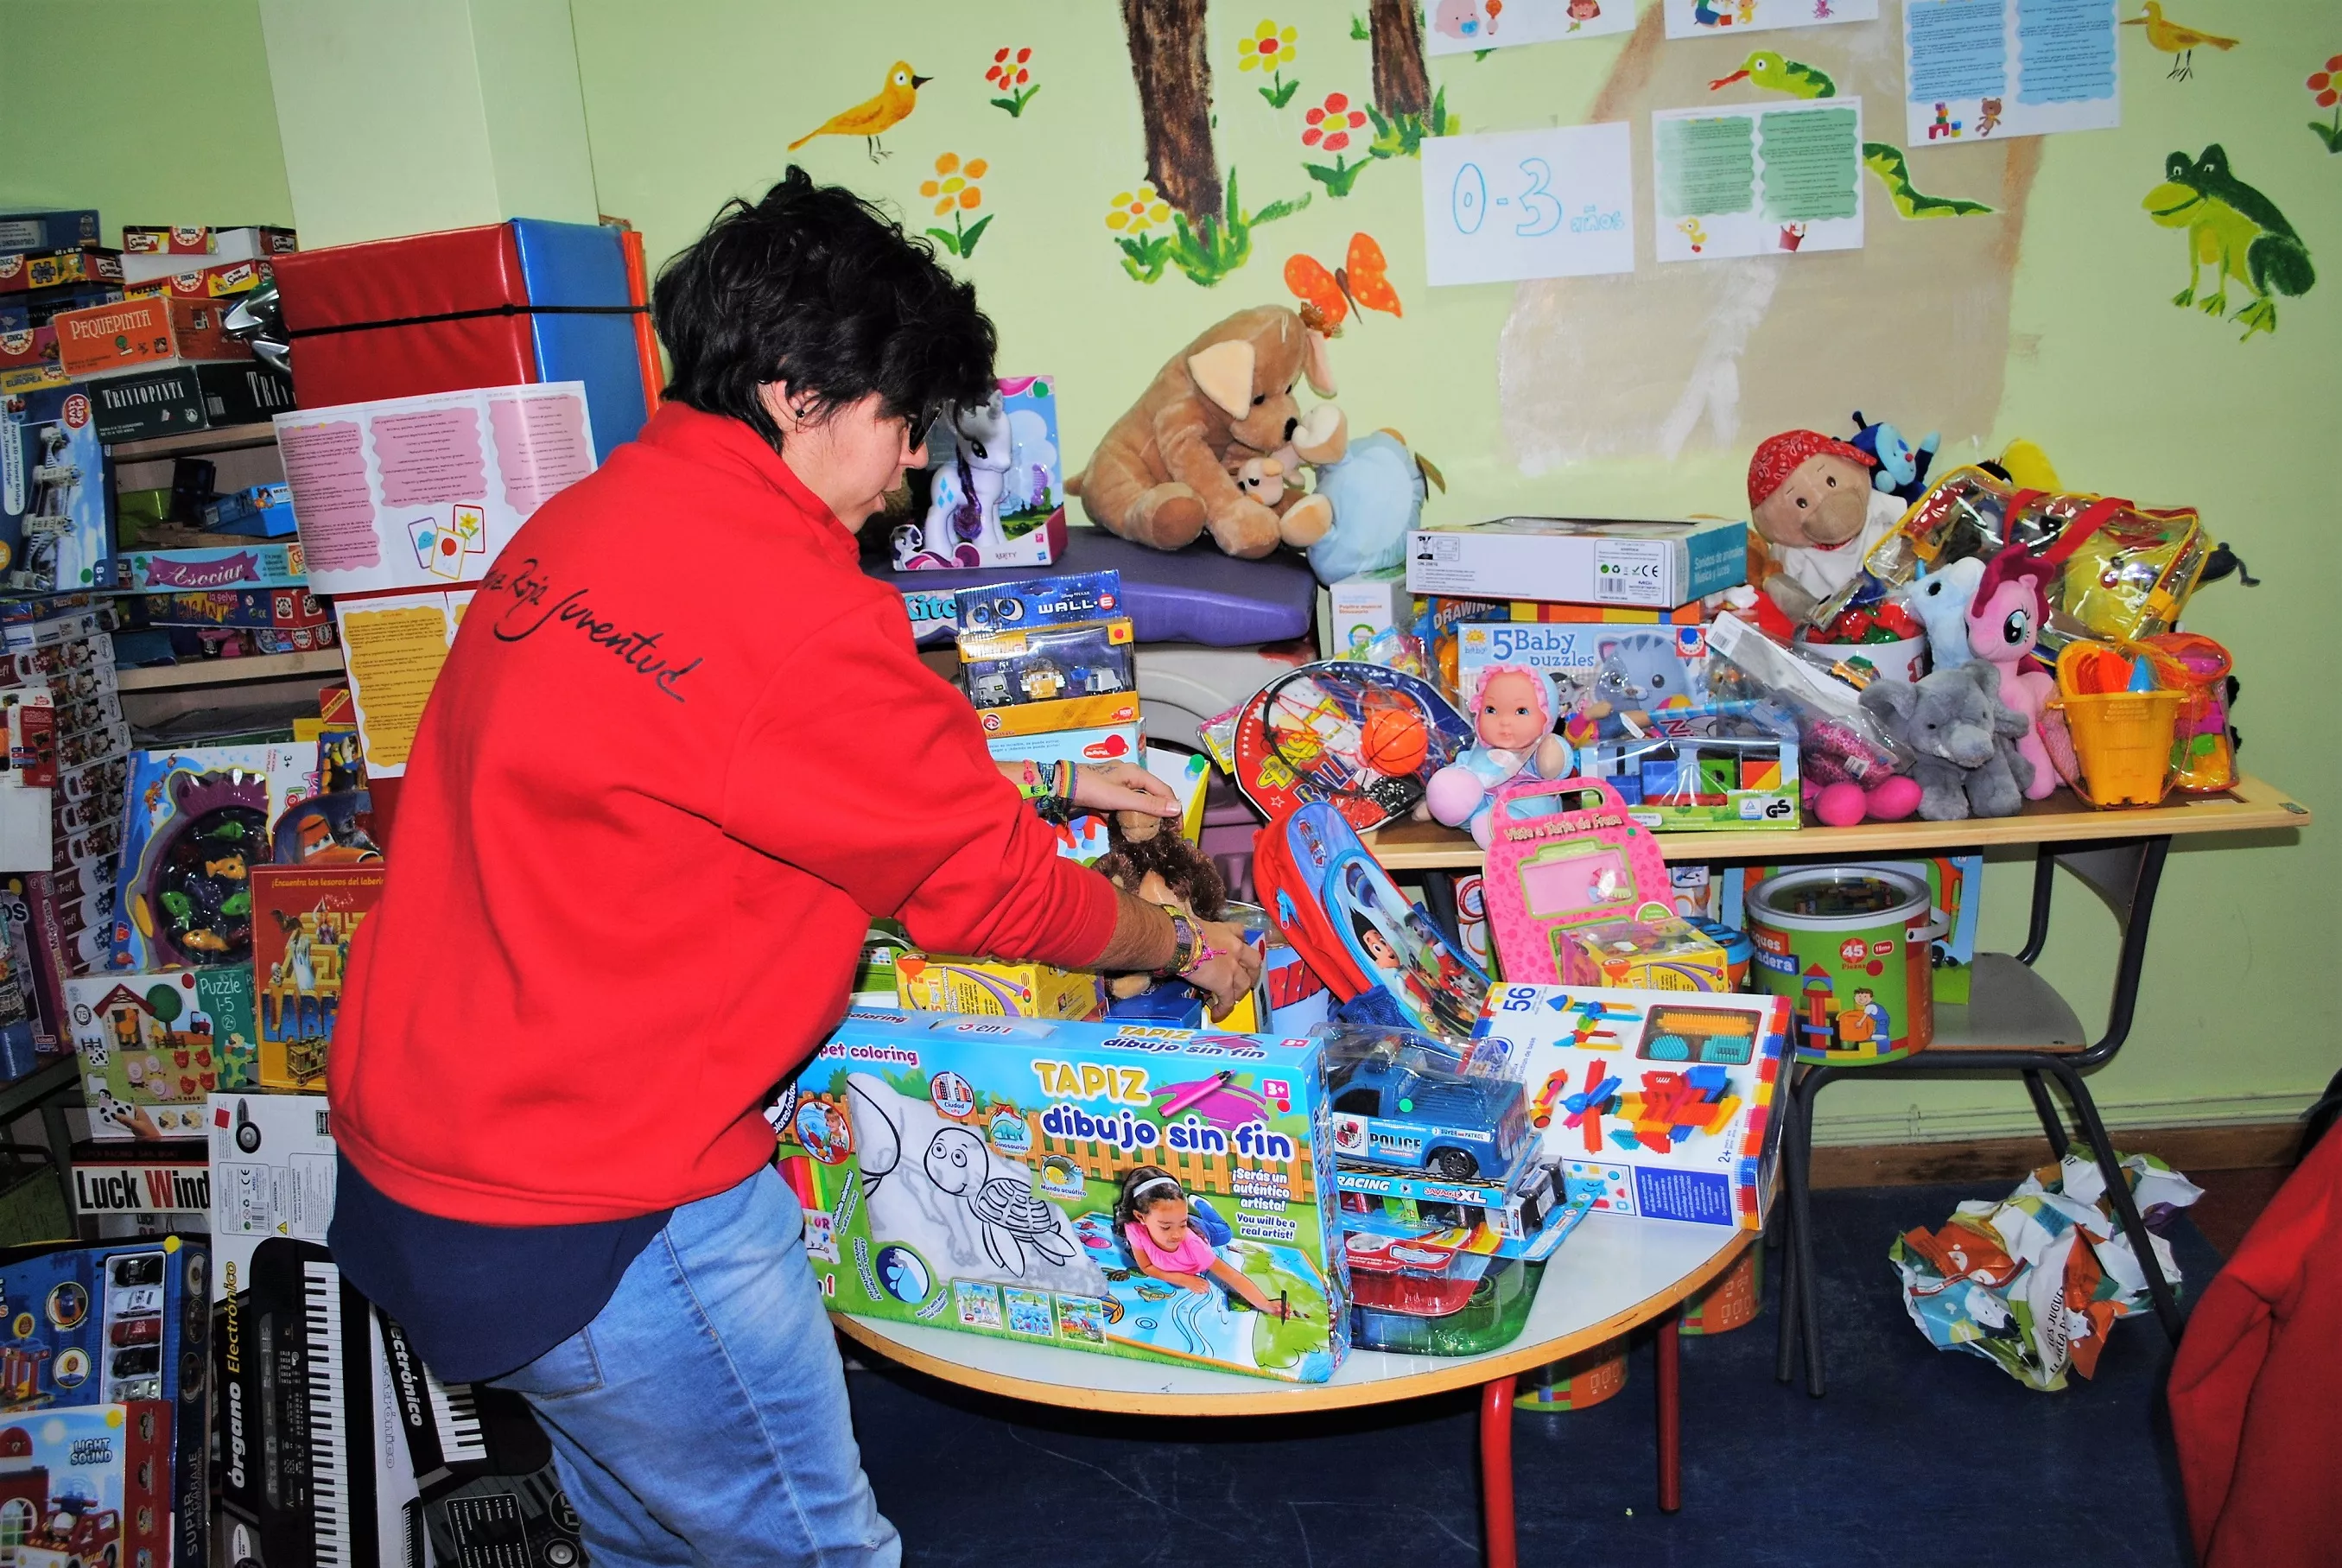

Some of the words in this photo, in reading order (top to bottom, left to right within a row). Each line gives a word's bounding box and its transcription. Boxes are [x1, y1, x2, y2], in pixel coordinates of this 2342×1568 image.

[130, 283, 162, 295] PUZZLE
[69, 309, 152, 340] PEQUEPINTA
[102, 381, 184, 409] TRIVIOPINTA
[156, 562, 245, 587] Asociar
[1464, 645, 1488, 656] baby
[1493, 630, 1513, 660] 5
[1515, 629, 1576, 655] Baby
[1529, 653, 1595, 668] puzzles
[283, 755, 293, 768] 3+
[1765, 799, 1791, 819] GS
[1504, 825, 1532, 842] Viste
[1545, 818, 1575, 836] Tarta
[1577, 819, 1590, 831] de
[1594, 813, 1622, 829] Fresa
[308, 878, 321, 886] los
[1842, 944, 1863, 957] 45
[200, 978, 243, 996] Puzzle
[215, 997, 235, 1013] 1-5
[1503, 987, 1538, 1013] 56
[78, 1010, 88, 1019] 75
[1118, 1025, 1193, 1039] TAPIZ
[851, 1046, 918, 1066] coloring
[1103, 1038, 1180, 1053] dibujo
[1186, 1044, 1221, 1056] sin
[1229, 1048, 1266, 1059] fin
[1035, 1063, 1149, 1102] TAPIZ
[1267, 1082, 1285, 1095] 3+
[1043, 1105, 1156, 1148] dibujo
[1170, 1117, 1224, 1152] sin
[1234, 1123, 1291, 1159] fin
[994, 1140, 1029, 1152] Dinosaurios
[1369, 1133, 1422, 1153] POLICE
[1717, 1147, 1730, 1164] 2+
[1232, 1168, 1270, 1183] ¡Serás
[1272, 1173, 1288, 1184] un
[1337, 1175, 1390, 1191] RACING
[76, 1170, 142, 1209] Luck
[144, 1170, 211, 1209] Wind
[1040, 1184, 1061, 1193] Mundo
[1061, 1187, 1087, 1197] acuático
[1232, 1181, 1291, 1199] auténtico
[1424, 1187, 1459, 1199] SAVAGE
[1457, 1189, 1487, 1203] XL
[1240, 1196, 1286, 1212] artista!
[1236, 1212, 1254, 1225] You
[1255, 1216, 1273, 1227] will
[1275, 1217, 1287, 1228] be
[1241, 1226, 1260, 1237] real
[1262, 1228, 1293, 1241] artist!
[224, 1260, 240, 1374] Electrónico
[390, 1326, 422, 1427] ectrónico
[73, 1438, 111, 1453] LIGHT
[70, 1451, 113, 1465] SOUND
[184, 1494, 199, 1557] SUPER
